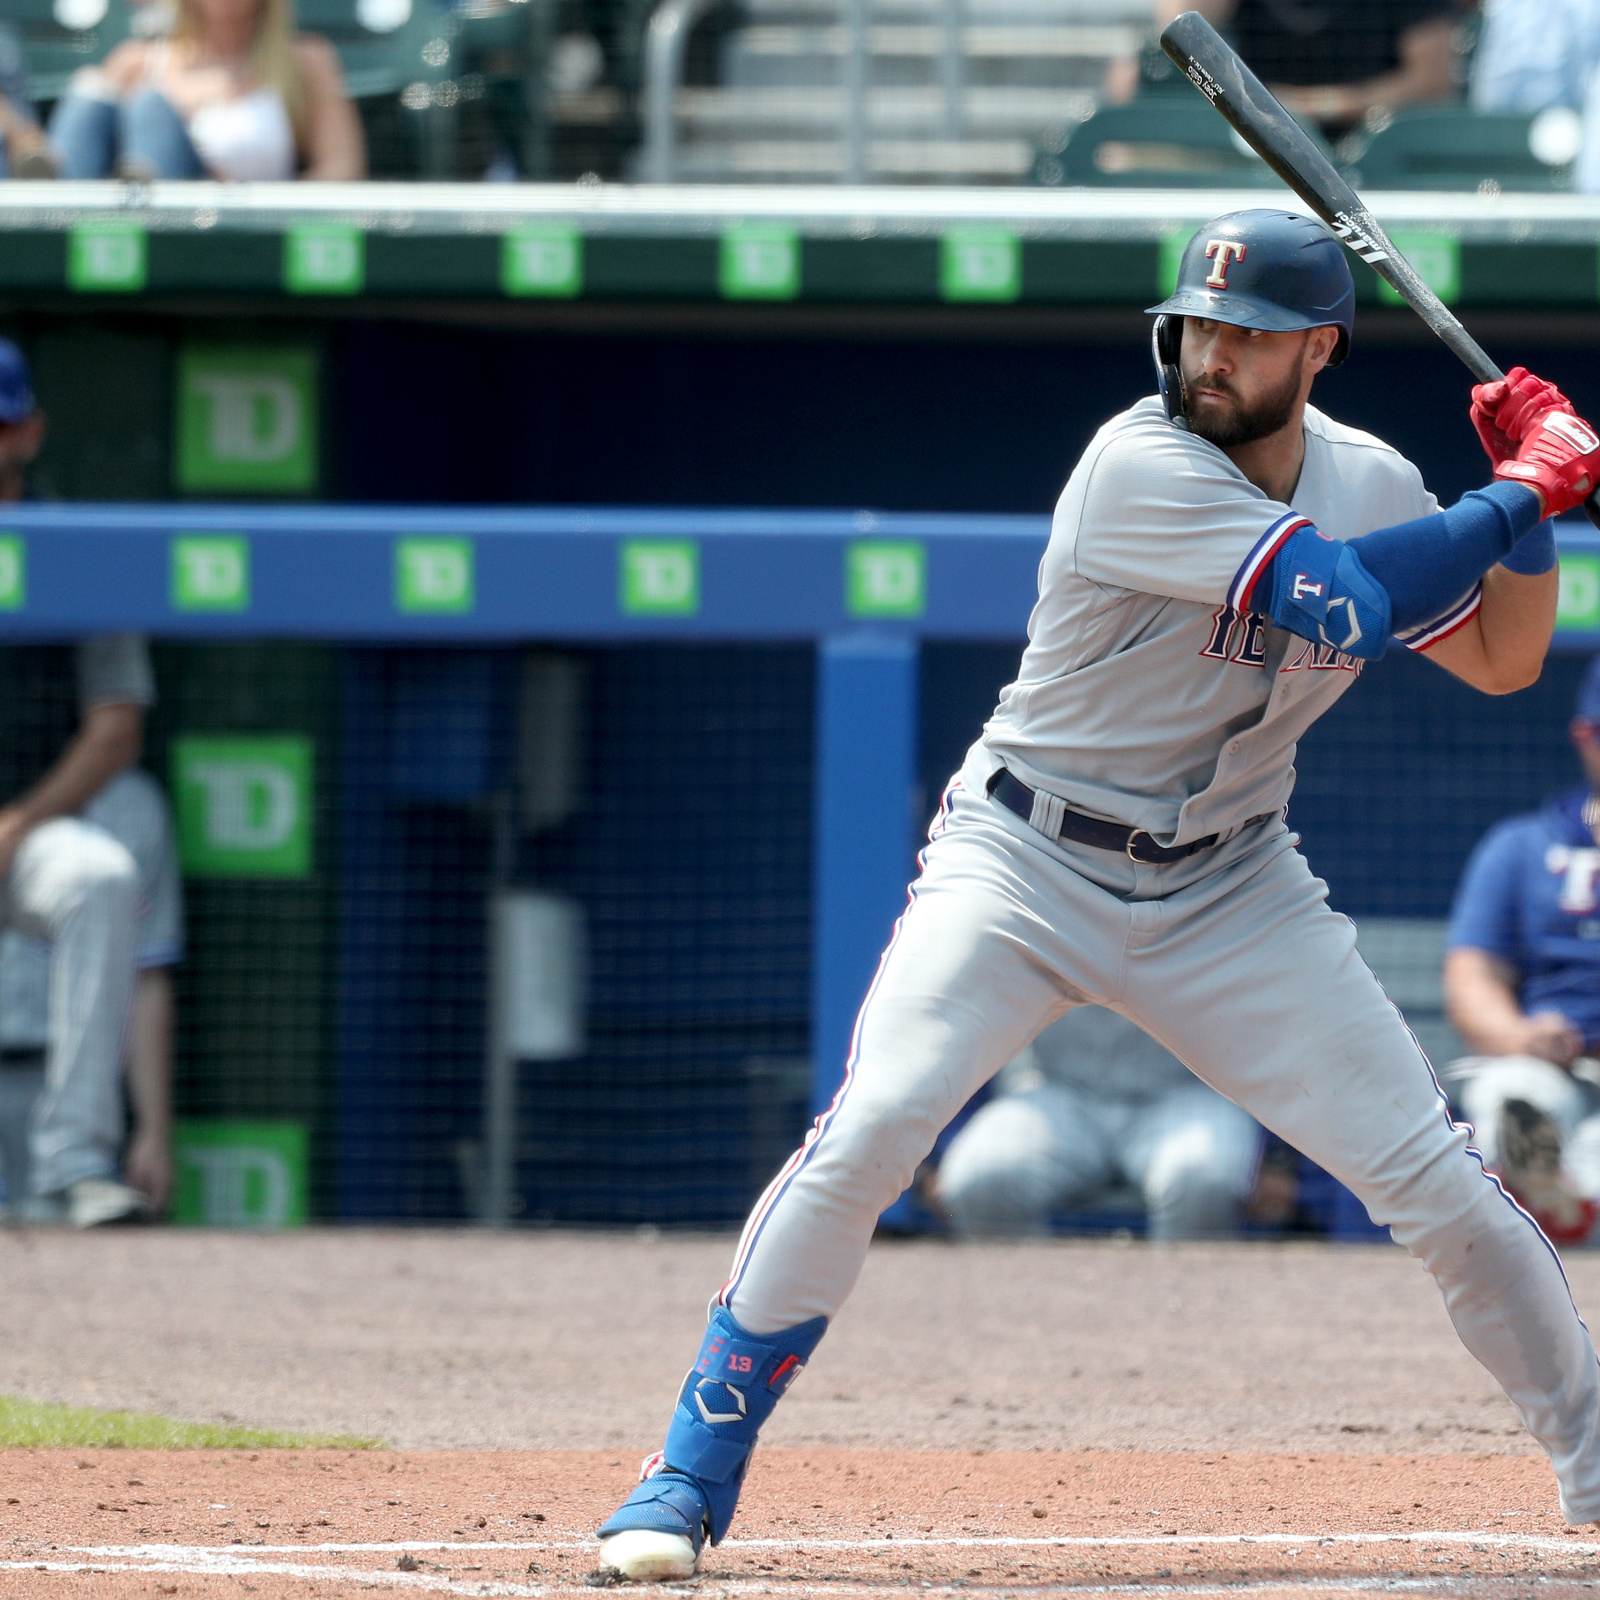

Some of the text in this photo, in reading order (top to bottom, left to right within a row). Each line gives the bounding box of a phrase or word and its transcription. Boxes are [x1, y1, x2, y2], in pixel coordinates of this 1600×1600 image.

[1188, 66, 1203, 85] Gallo
[1202, 81, 1217, 99] Joey
[1334, 211, 1382, 251] marucci
[82, 234, 142, 281] TD
[298, 234, 358, 281] TD
[514, 236, 575, 284] TD
[731, 237, 792, 286] TD
[949, 239, 1011, 288] TD
[1205, 239, 1247, 290] T
[189, 370, 300, 462] TD
[186, 548, 244, 596] TD
[408, 549, 470, 599] TD
[633, 551, 694, 601] TD
[858, 553, 920, 603] TD
[1293, 572, 1325, 600] T
[187, 761, 298, 850] TD
[728, 1354, 753, 1373] 13
